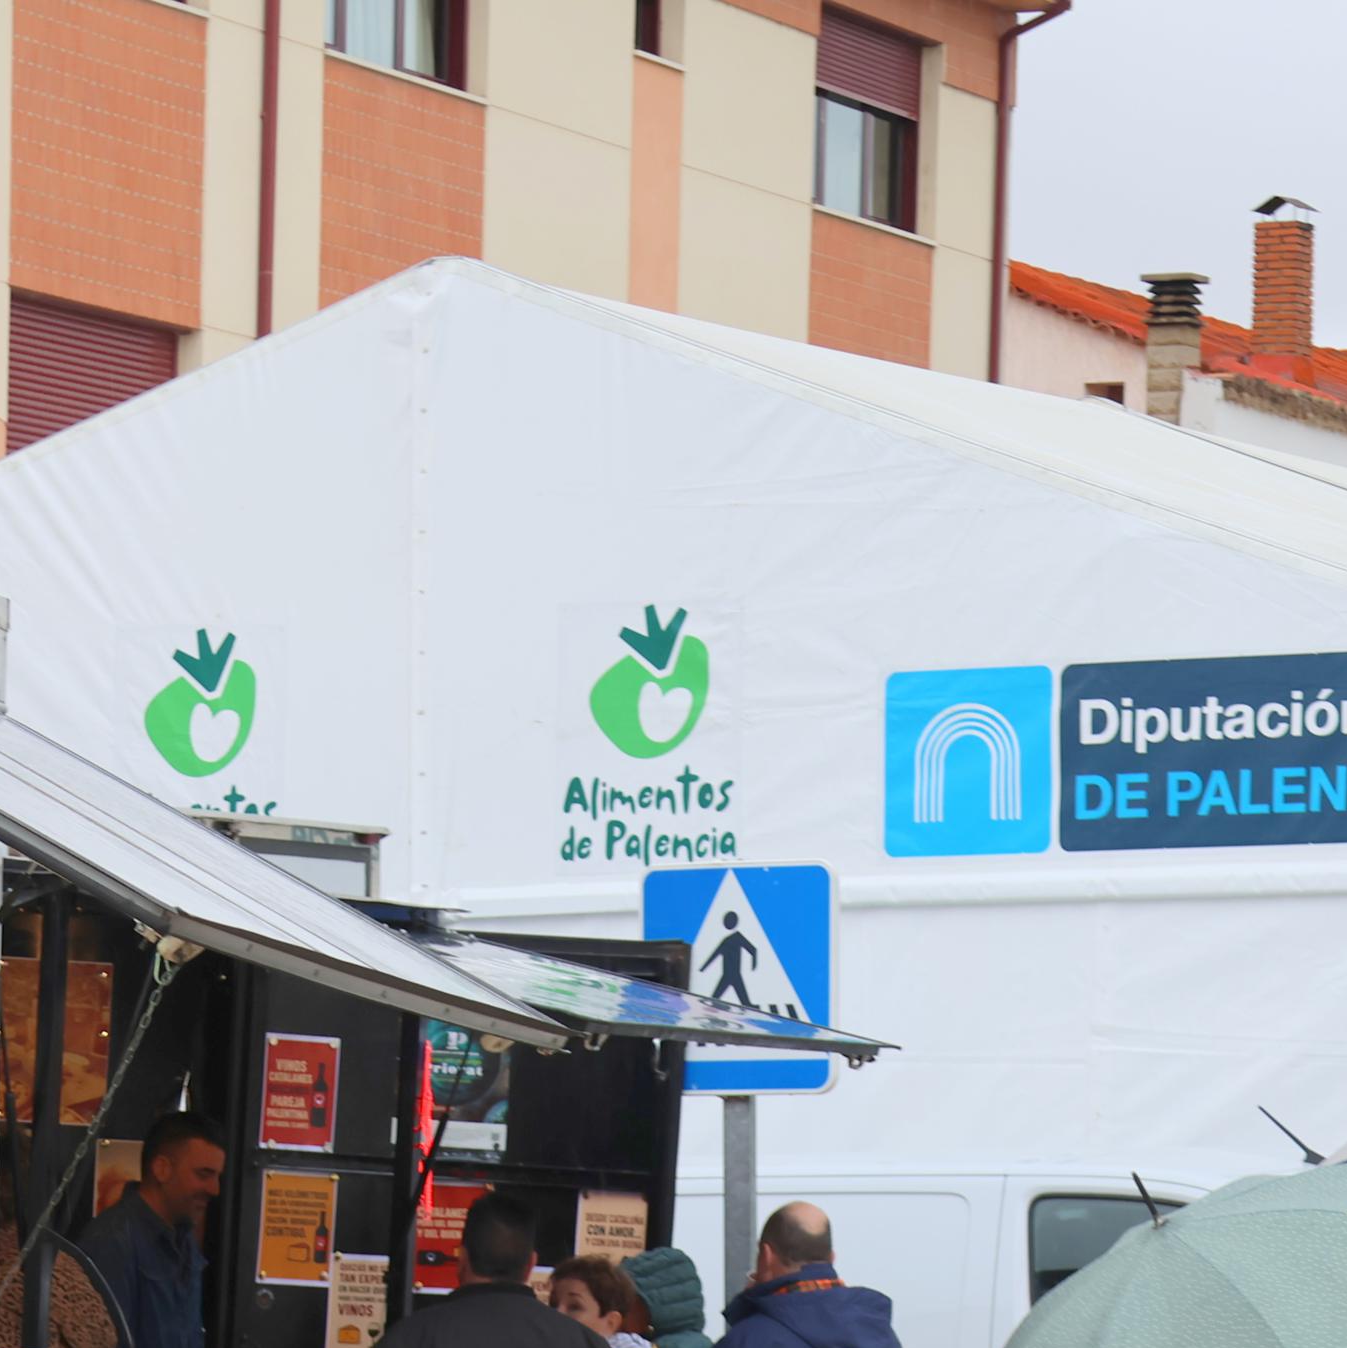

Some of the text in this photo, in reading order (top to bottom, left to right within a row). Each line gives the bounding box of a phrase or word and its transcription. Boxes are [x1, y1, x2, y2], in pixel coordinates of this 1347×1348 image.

[563, 764, 734, 821] Alimentos
[1074, 773, 1149, 821] DE
[561, 819, 737, 867] de Palencia
[587, 1224, 606, 1236] CON
[338, 1303, 373, 1317] VINOS
